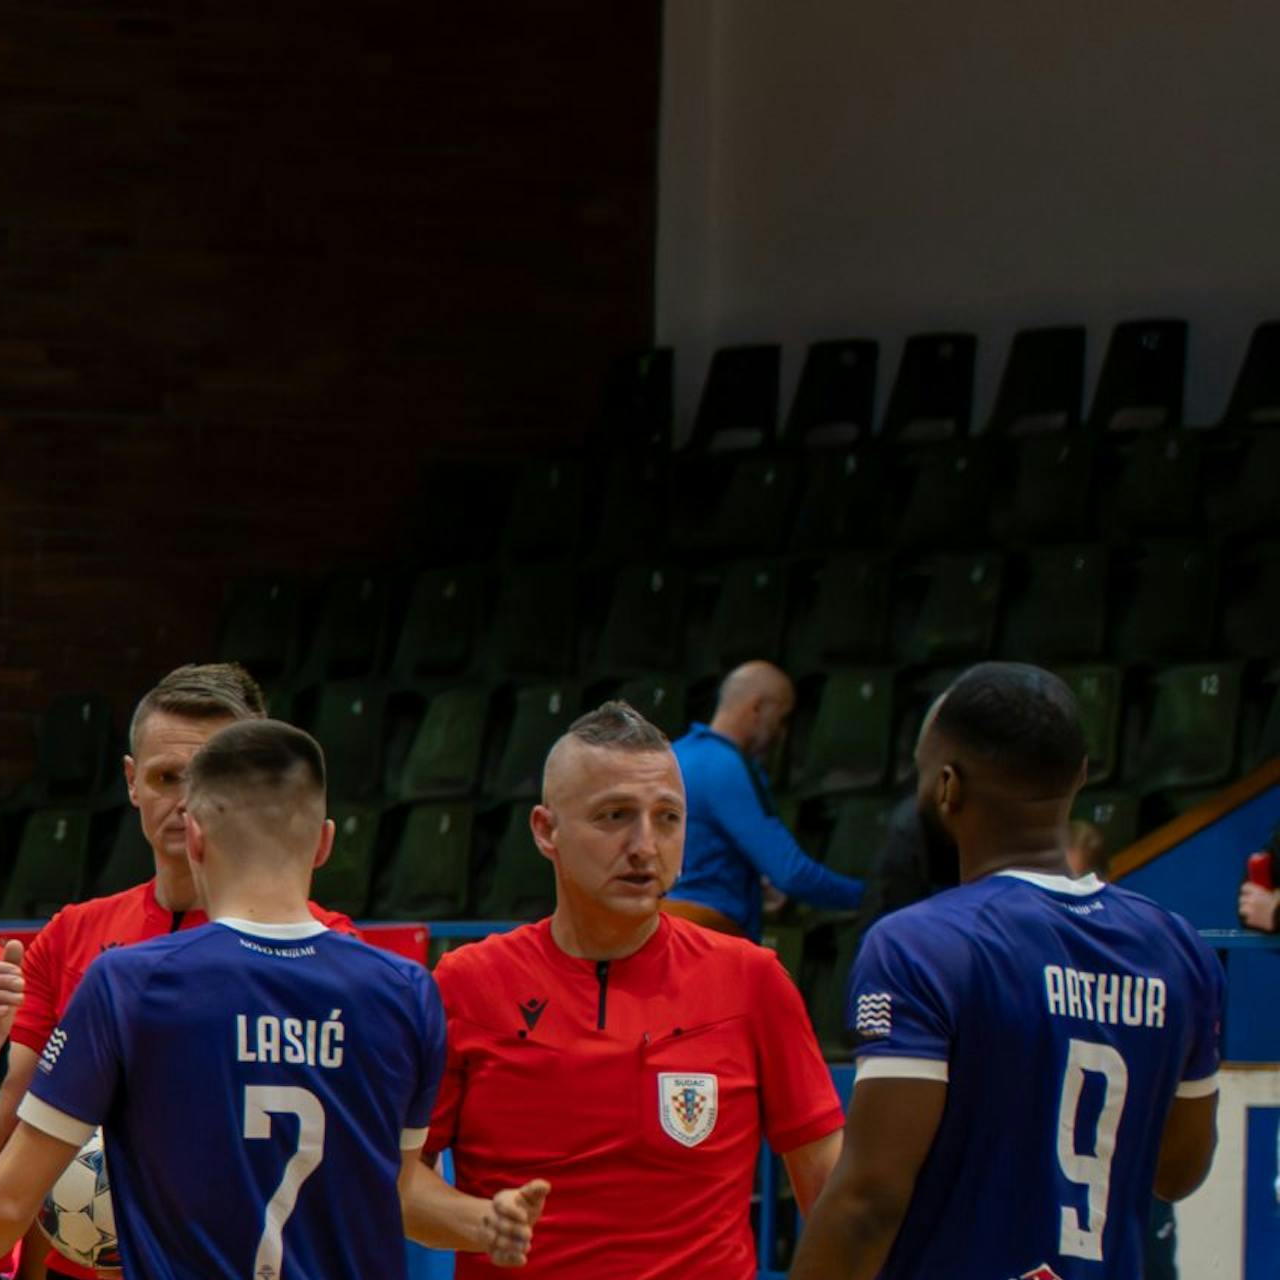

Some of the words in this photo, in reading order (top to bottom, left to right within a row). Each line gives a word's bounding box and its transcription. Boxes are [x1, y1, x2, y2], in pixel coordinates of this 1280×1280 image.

[1044, 965, 1167, 1028] ARTHUR
[236, 1009, 345, 1068] LASIĆ
[1056, 1038, 1128, 1261] 9
